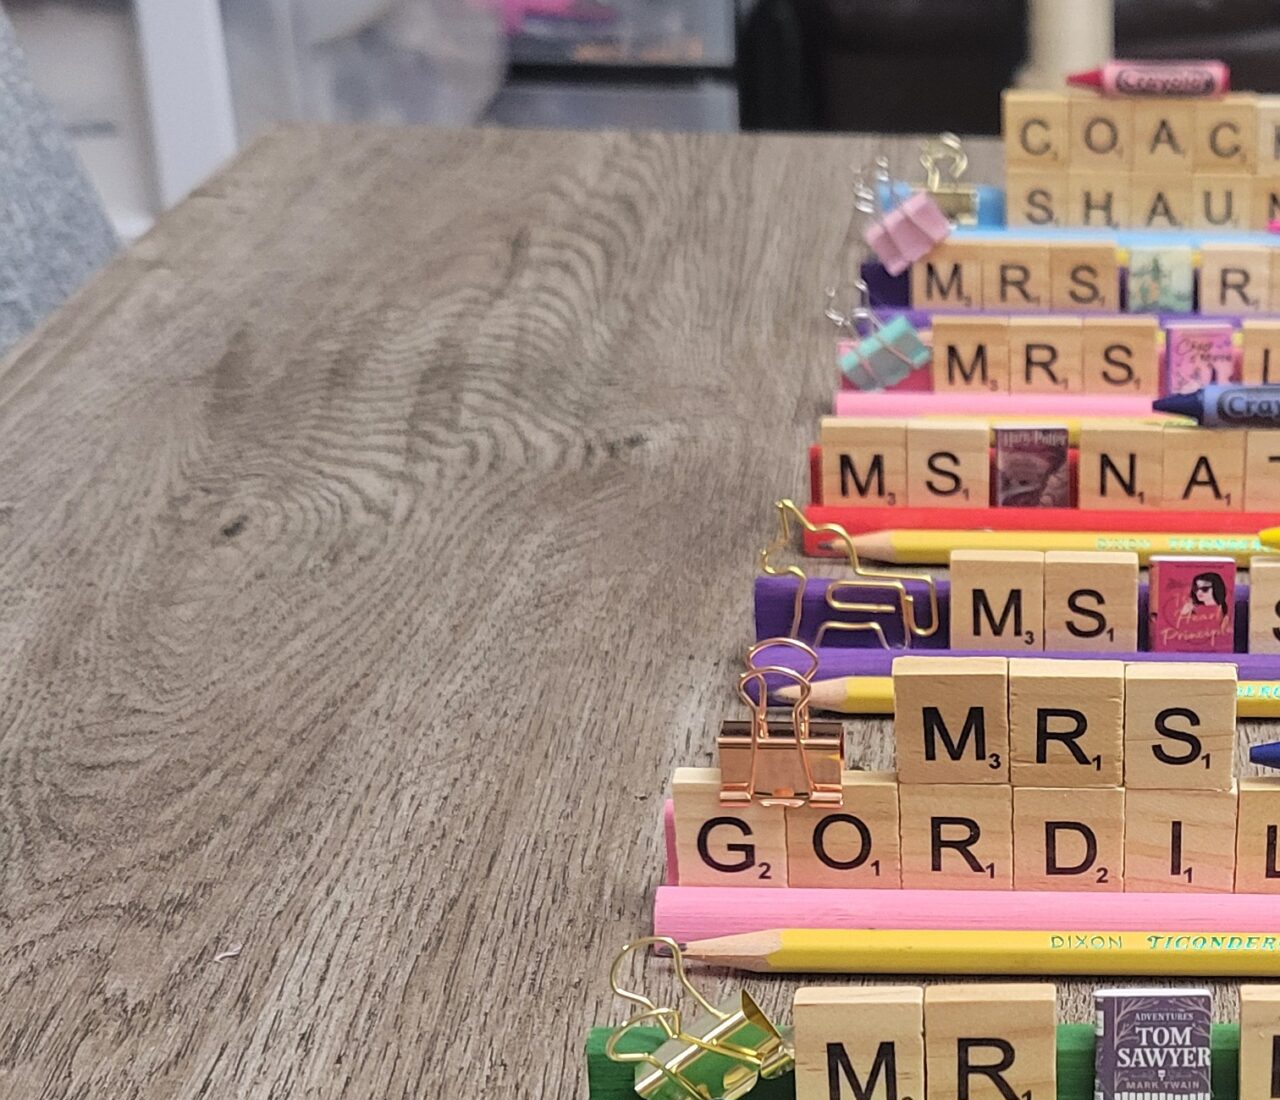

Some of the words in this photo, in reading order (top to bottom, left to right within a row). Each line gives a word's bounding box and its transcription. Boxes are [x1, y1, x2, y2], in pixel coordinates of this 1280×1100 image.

[926, 262, 1101, 304] MRS
[947, 343, 1135, 386] MRS
[840, 450, 964, 499] MS
[972, 588, 1107, 639] MS
[921, 706, 1203, 766] MRS
[1050, 935, 1123, 949] DIXON
[1135, 1011, 1194, 1022] ADVENTURES
[1135, 1026, 1193, 1047] TOM
[1116, 1046, 1212, 1068] SAWYER
[1126, 1081, 1160, 1090] MARK
[1163, 1081, 1200, 1090] TWAIN
